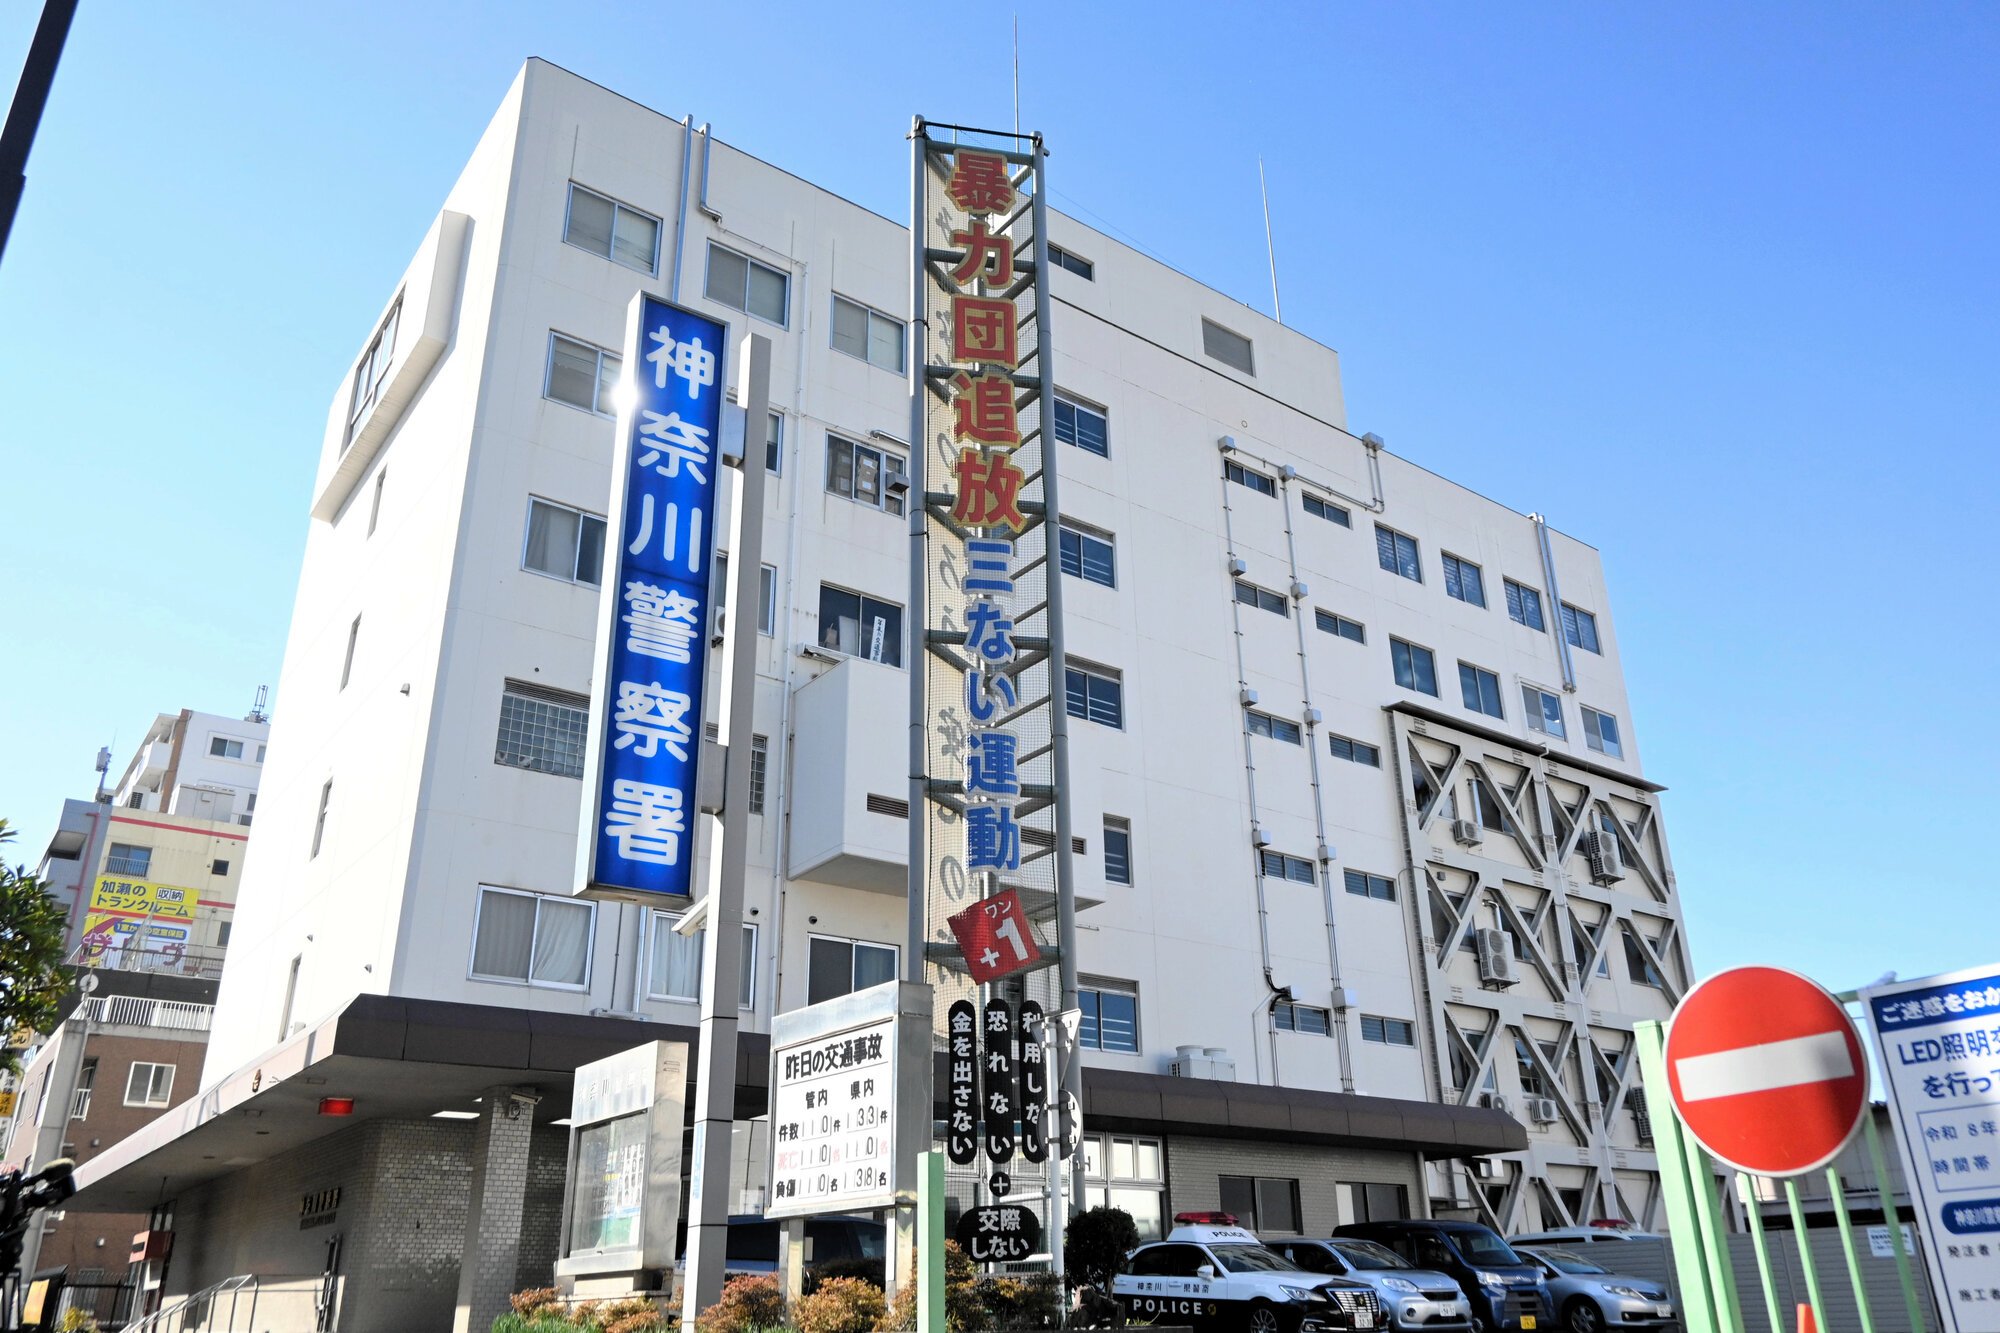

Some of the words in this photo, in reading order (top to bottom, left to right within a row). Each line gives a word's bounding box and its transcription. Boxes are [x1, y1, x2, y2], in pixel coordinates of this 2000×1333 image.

[605, 325, 715, 866] 神奈川警察署
[100, 880, 147, 896] 加瀬の
[96, 894, 188, 917] トランクルーム
[985, 901, 1012, 919] ワン
[116, 922, 185, 938] 1室かの空室保証
[786, 1034, 883, 1080] 昨日の交通事故
[851, 1078, 874, 1100] 県内
[951, 1011, 973, 1156] 金を出さない
[987, 1011, 1011, 1155] 恐れない
[779, 1123, 799, 1142] 件数
[1925, 1125, 1957, 1142] 令和
[776, 1179, 796, 1199] 負傷
[878, 1171, 887, 1186] 名
[978, 1208, 1021, 1232] 交際
[1212, 1231, 1247, 1239] POLICE
[972, 1236, 1028, 1259] しない
[1133, 1299, 1202, 1315] POLICE
